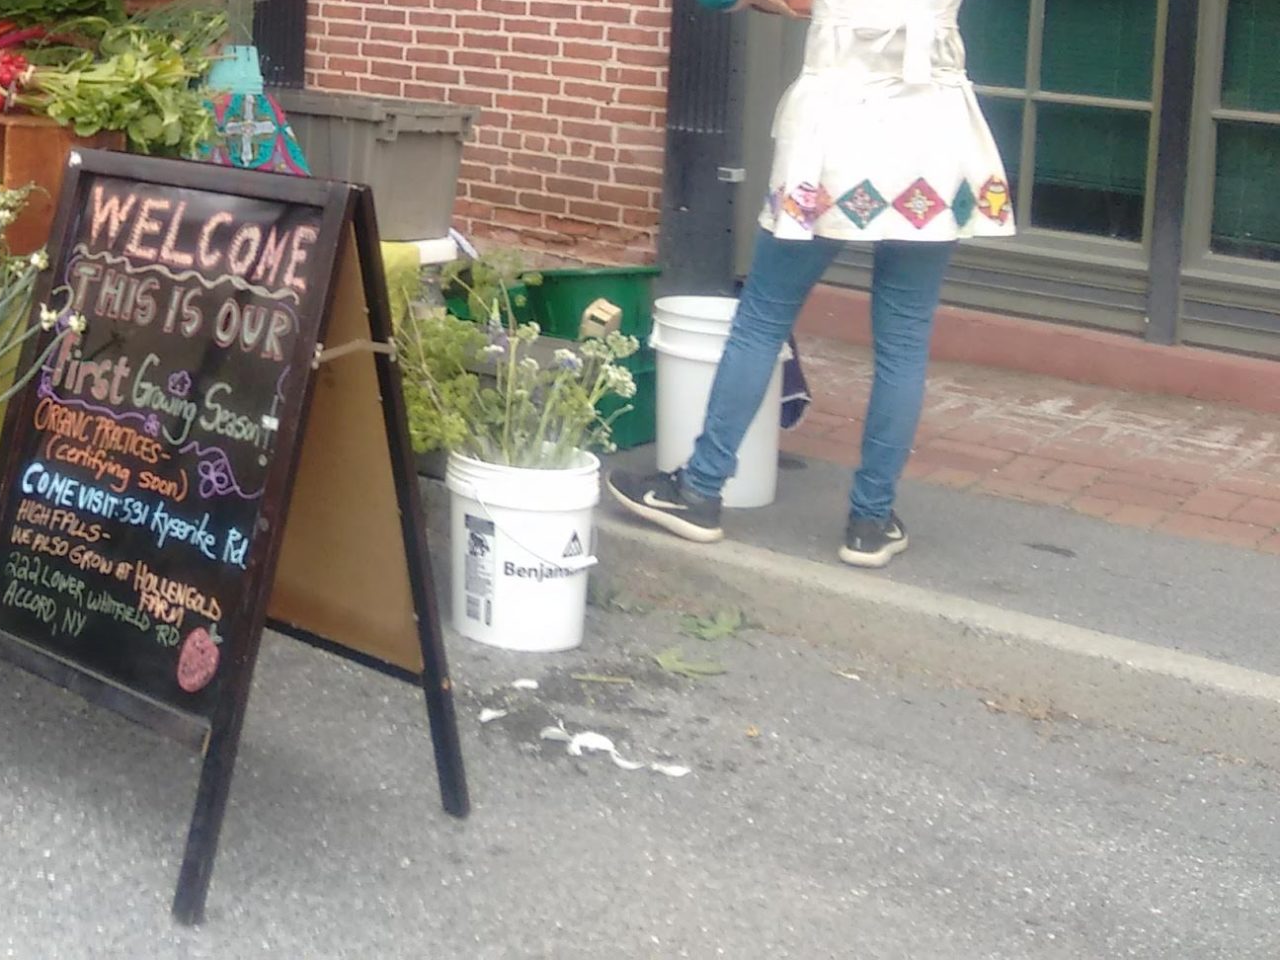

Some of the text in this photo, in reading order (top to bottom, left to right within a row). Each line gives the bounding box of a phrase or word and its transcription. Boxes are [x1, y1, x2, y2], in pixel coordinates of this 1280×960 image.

[91, 185, 321, 292] WELCOME
[74, 261, 293, 362] THIS IS OUR
[132, 353, 198, 445] Growing
[16, 498, 51, 527] HIGH
[22, 462, 81, 507] COME
[119, 497, 150, 525] 531
[10, 524, 34, 546] WE
[31, 533, 70, 557] ALSO
[69, 544, 114, 575] GROW
[115, 561, 134, 581] AT
[504, 561, 575, 583] Benjam
[41, 565, 86, 607] LOWER
[155, 624, 180, 648] RD
[61, 607, 87, 638] NY
[138, 592, 186, 629] FARM
